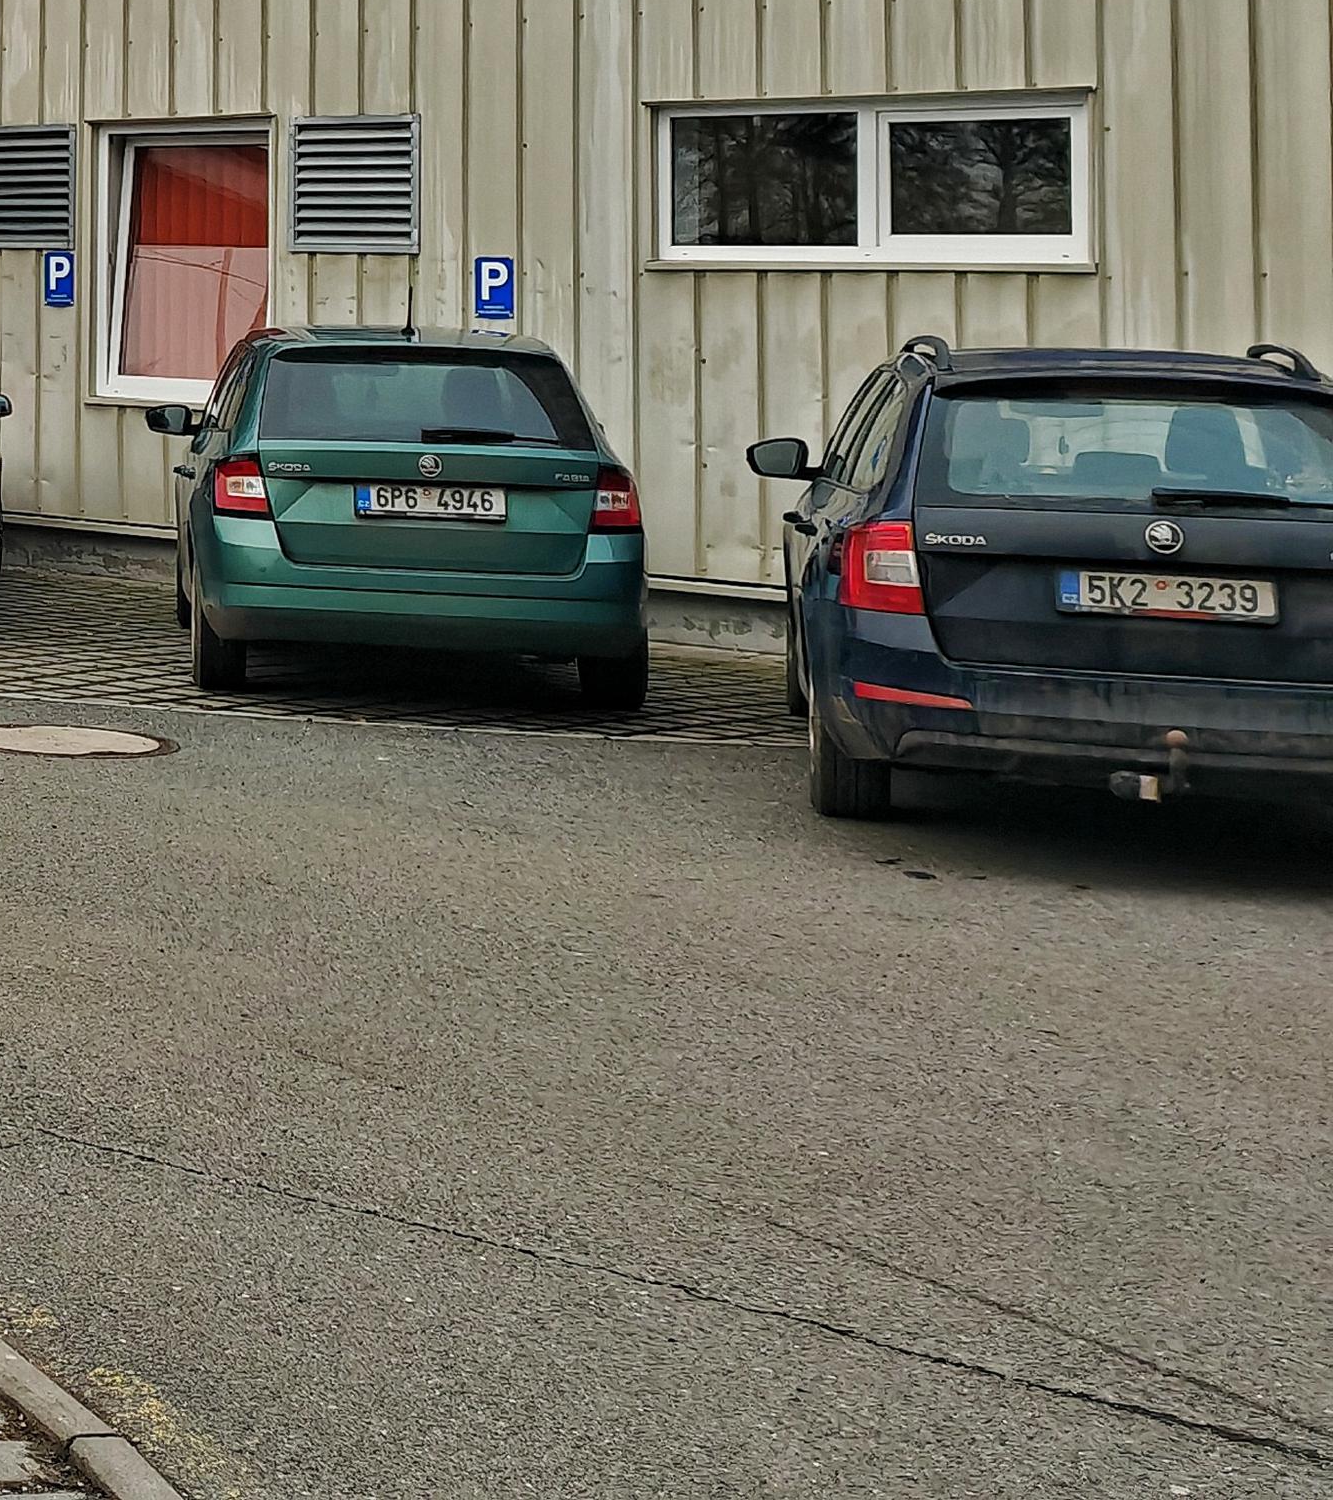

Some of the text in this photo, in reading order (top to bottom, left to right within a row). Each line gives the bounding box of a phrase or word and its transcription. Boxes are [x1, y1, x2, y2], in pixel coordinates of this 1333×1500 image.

[49, 256, 71, 291] P
[481, 261, 508, 301] P
[376, 486, 418, 509] 6P6
[436, 488, 494, 512] 4946
[1087, 575, 1149, 607] 5K2
[1176, 581, 1259, 613] 3239
